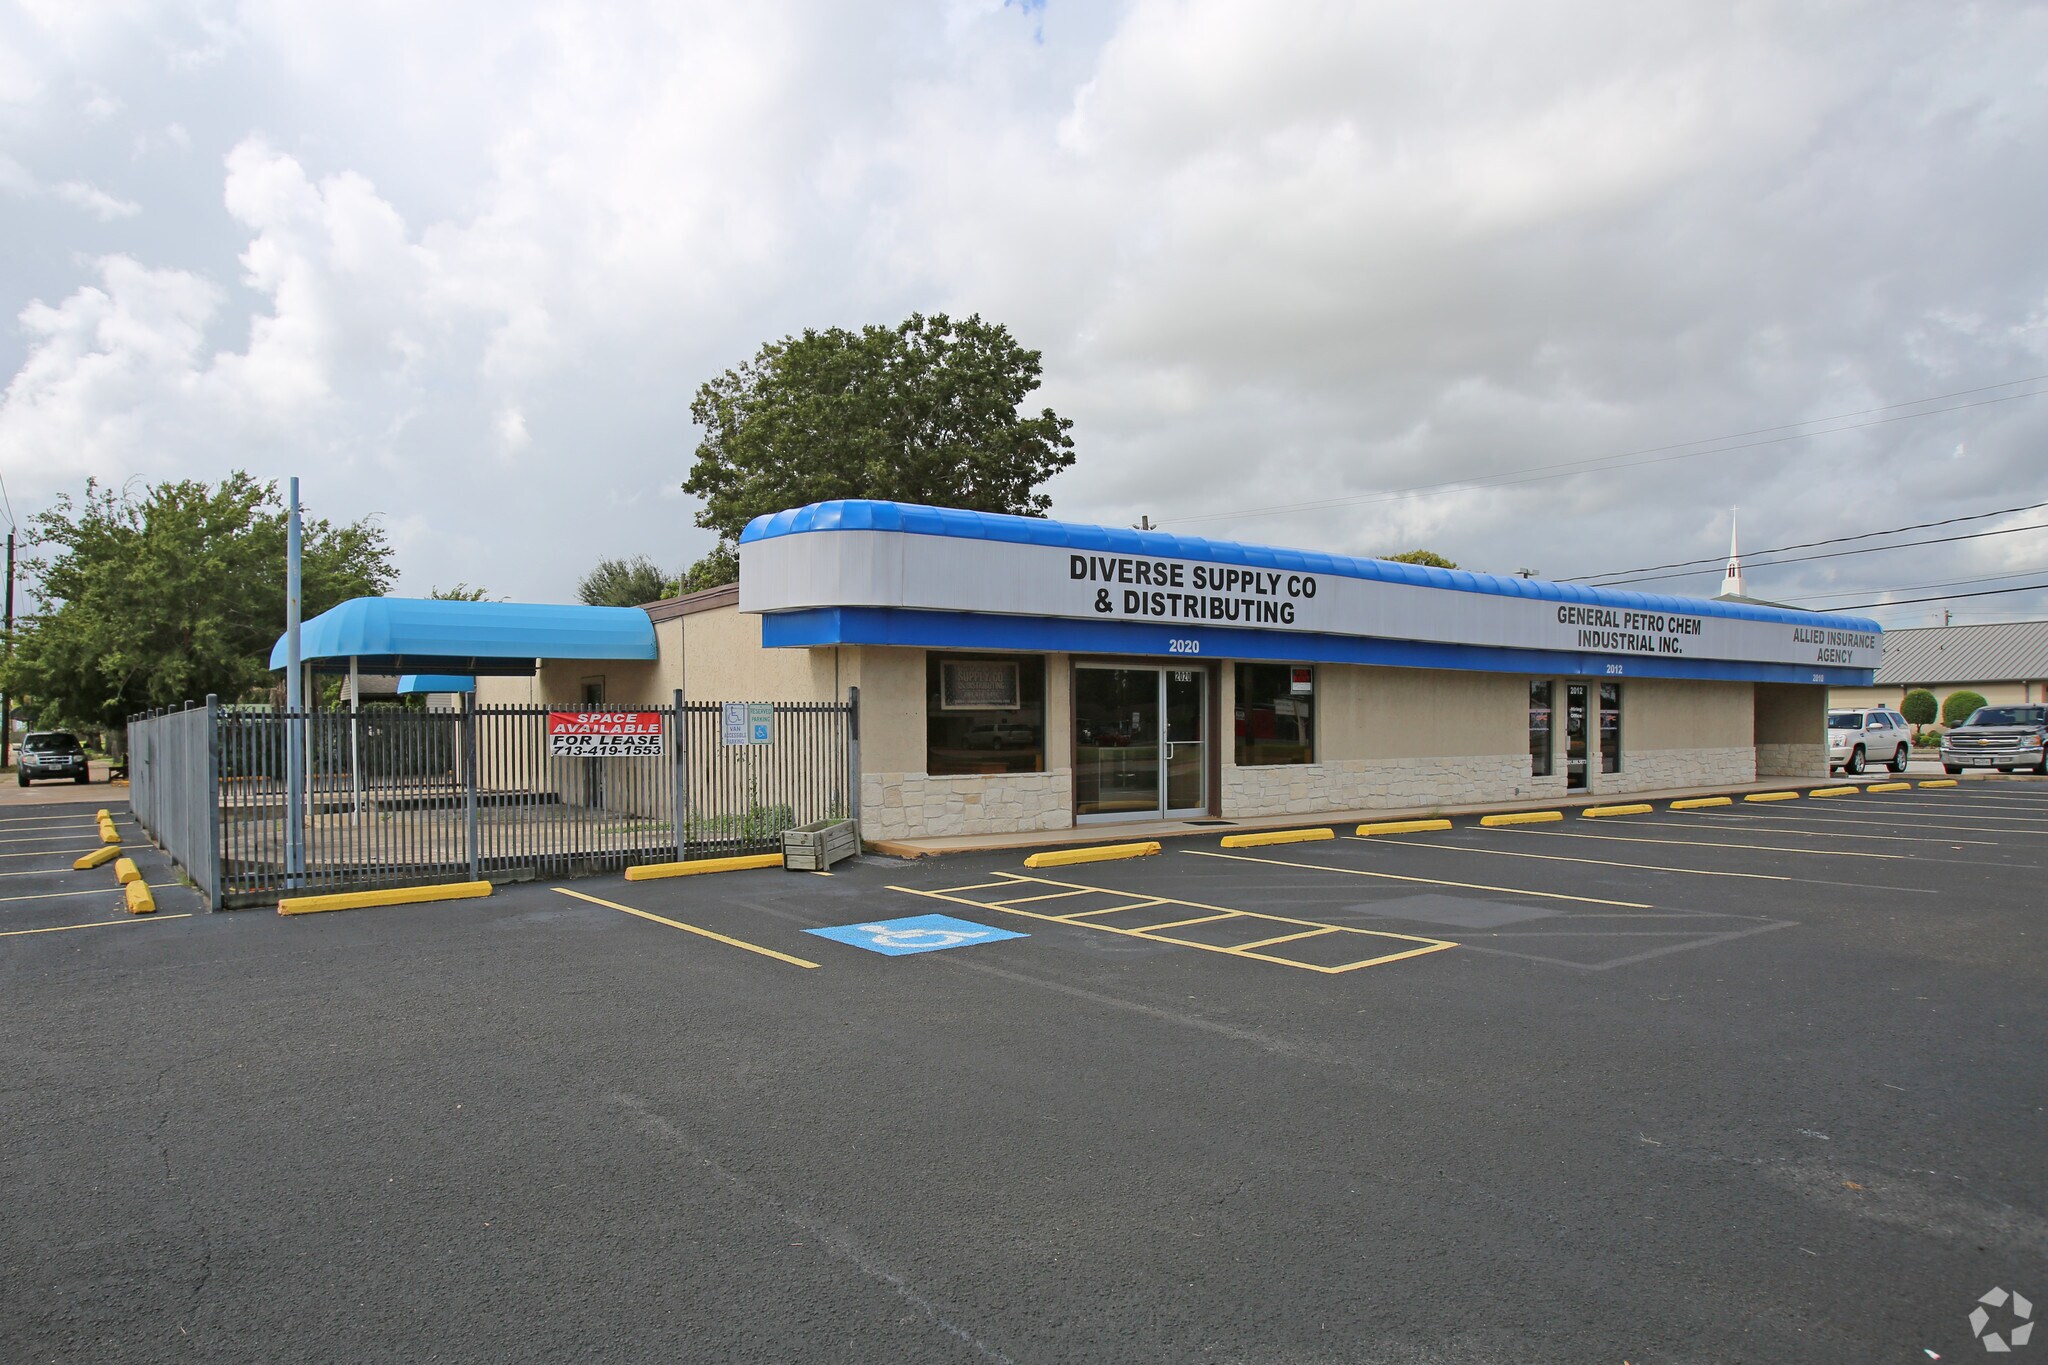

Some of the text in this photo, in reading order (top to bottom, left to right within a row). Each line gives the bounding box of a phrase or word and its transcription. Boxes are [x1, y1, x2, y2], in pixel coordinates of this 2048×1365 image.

[1070, 554, 1317, 599] DIVERSE SUPPLY CO
[1094, 588, 1295, 625] & DISTRIBUTING
[1557, 605, 1701, 635] GENERAL PETRO CHEM
[1577, 629, 1683, 653] INDUSTRIAL INC.
[1793, 627, 1875, 649] ALLIED INSURANCE
[1169, 639, 1200, 653] 2020
[1816, 647, 1853, 664] AGENCY
[1606, 664, 1623, 674] 2012
[1175, 671, 1192, 682] 2020
[1570, 687, 1583, 695] 2012
[577, 713, 638, 723] SPACE
[553, 724, 659, 733] AVAILABLE
[553, 735, 660, 746] FOR LEASE
[553, 745, 661, 756] 713-419-1553
